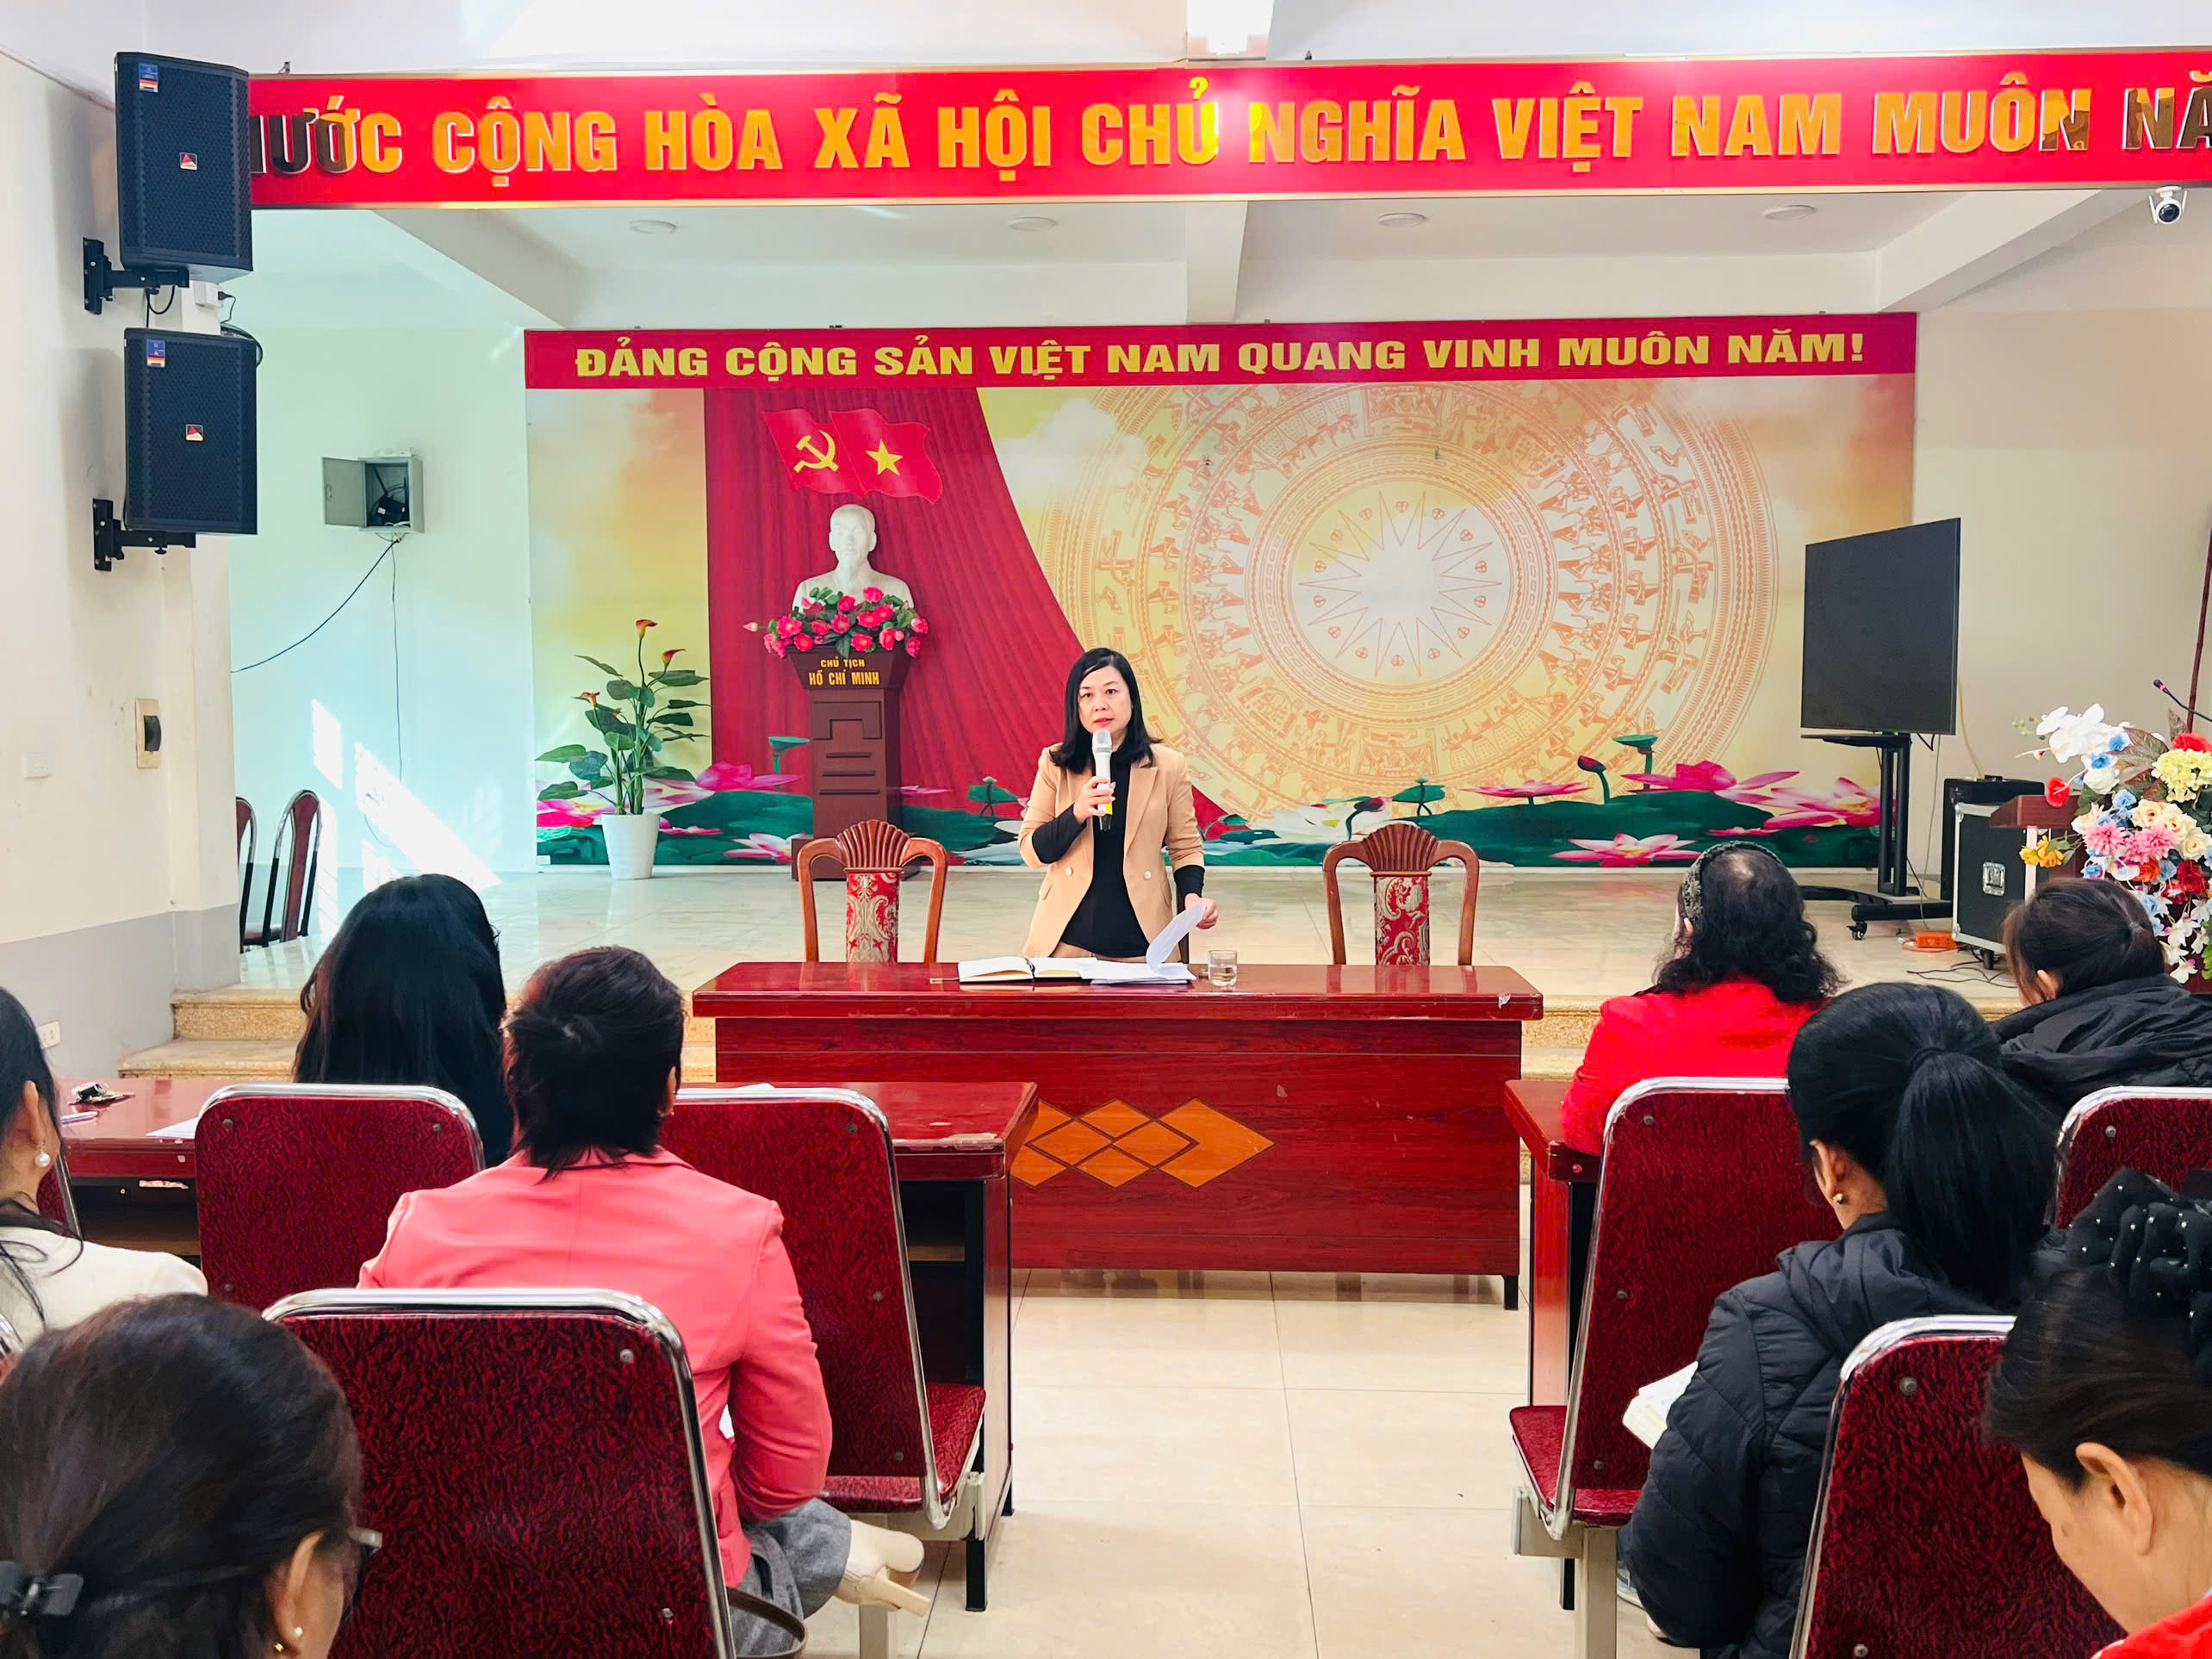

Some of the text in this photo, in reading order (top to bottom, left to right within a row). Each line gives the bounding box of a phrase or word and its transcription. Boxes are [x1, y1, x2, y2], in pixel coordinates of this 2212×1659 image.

[433, 96, 618, 187] CỘNG
[644, 93, 783, 171] HÒA
[813, 92, 910, 169] XÃ
[937, 89, 1051, 182] HỘI
[1081, 76, 1219, 166] CHỦ
[1249, 84, 1466, 164] NGHĨA
[1492, 81, 1644, 173] VIỆT
[1671, 93, 1842, 158] NAM
[1872, 71, 2091, 154] MUÔN
[575, 328, 1864, 382] ĐẢNG CỘNG SẢN VIỆT NAM QUANG VINH MUÔN NĂM!
[820, 656, 866, 668] CHỦ TỊCH
[828, 668, 846, 686] CHÍ
[851, 671, 879, 686] MINH
